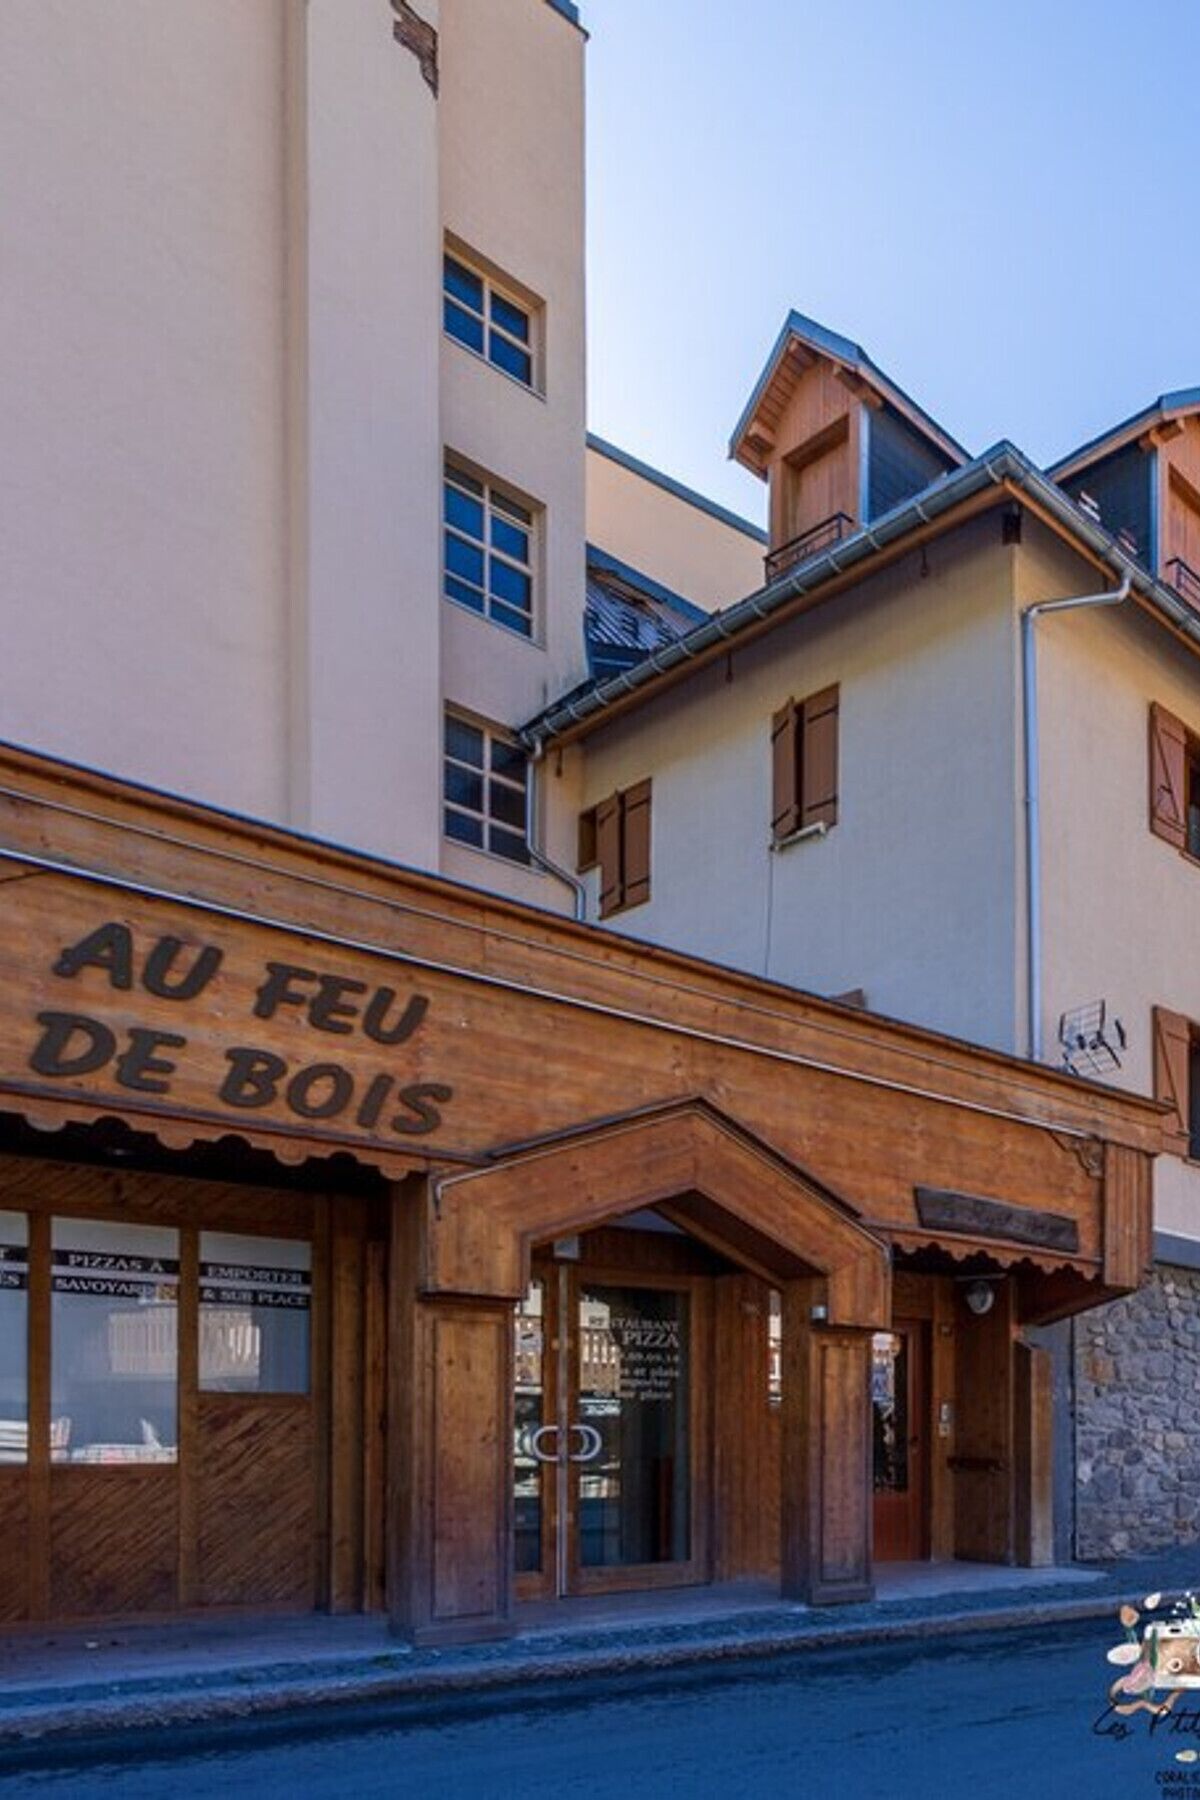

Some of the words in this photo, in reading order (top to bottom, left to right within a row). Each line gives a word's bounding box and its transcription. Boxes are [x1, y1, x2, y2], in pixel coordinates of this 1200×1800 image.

[51, 922, 224, 1000] AU
[252, 962, 429, 1046] FEU
[29, 1010, 187, 1093] DE
[218, 1046, 453, 1135] BOIS
[69, 1253, 142, 1270] PIZZAS
[207, 1265, 302, 1283] EMPORTER
[203, 1288, 215, 1300] &
[220, 1291, 252, 1303] SUR
[258, 1292, 307, 1305] PLACE
[622, 1331, 679, 1348] PIZZA
